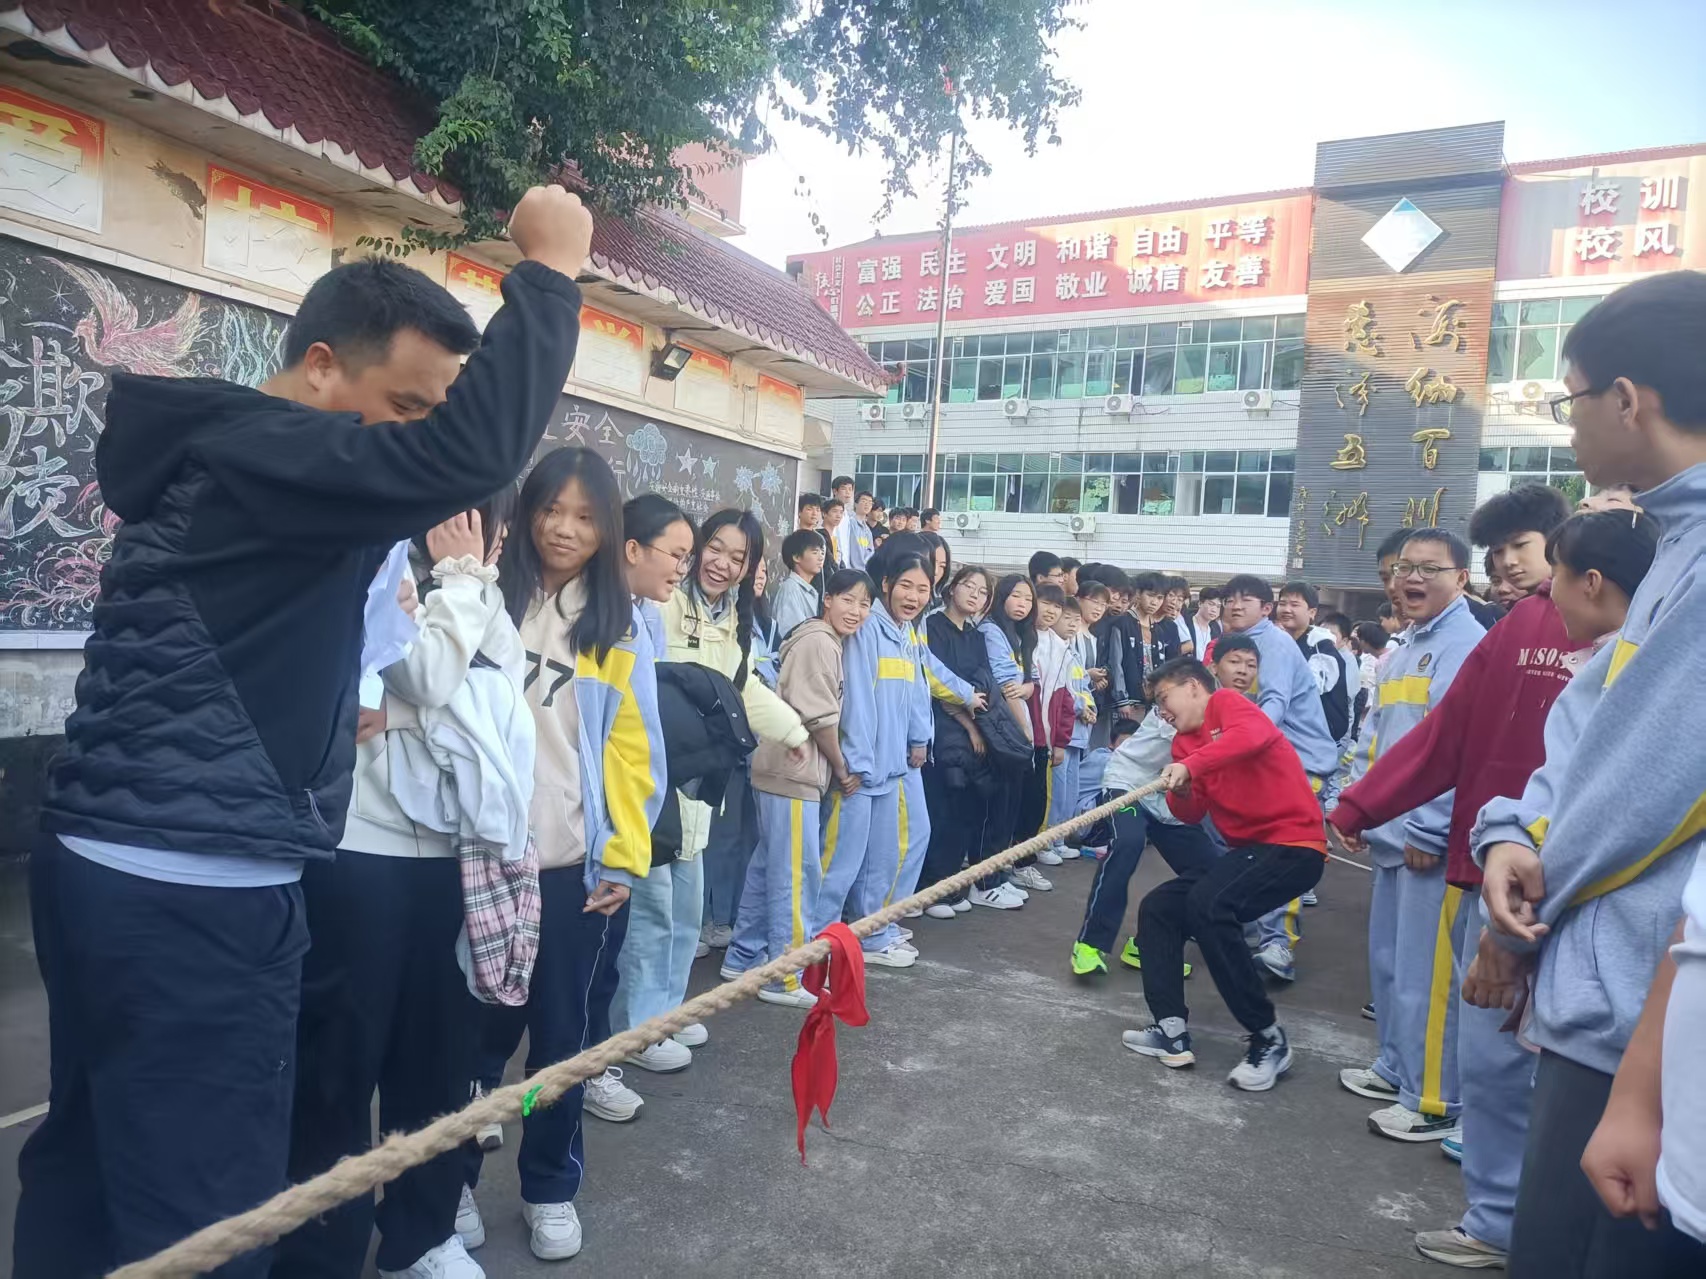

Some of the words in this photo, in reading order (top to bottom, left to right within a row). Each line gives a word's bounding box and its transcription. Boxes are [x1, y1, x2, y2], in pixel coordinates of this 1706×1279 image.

[1579, 176, 1681, 216] 校训
[857, 254, 902, 284] 富强
[919, 248, 967, 277] 民主
[986, 240, 1037, 270] 文明
[1056, 231, 1112, 263] 和谐
[1133, 226, 1182, 257] 自由
[1205, 216, 1267, 249] 平等
[1576, 223, 1676, 262] 校风
[855, 290, 901, 318] 公正
[917, 284, 964, 312] 法治
[984, 276, 1036, 306] 爱国
[1055, 271, 1108, 300] 敬业
[1127, 263, 1183, 294] 诚信
[1200, 256, 1264, 290] 友善
